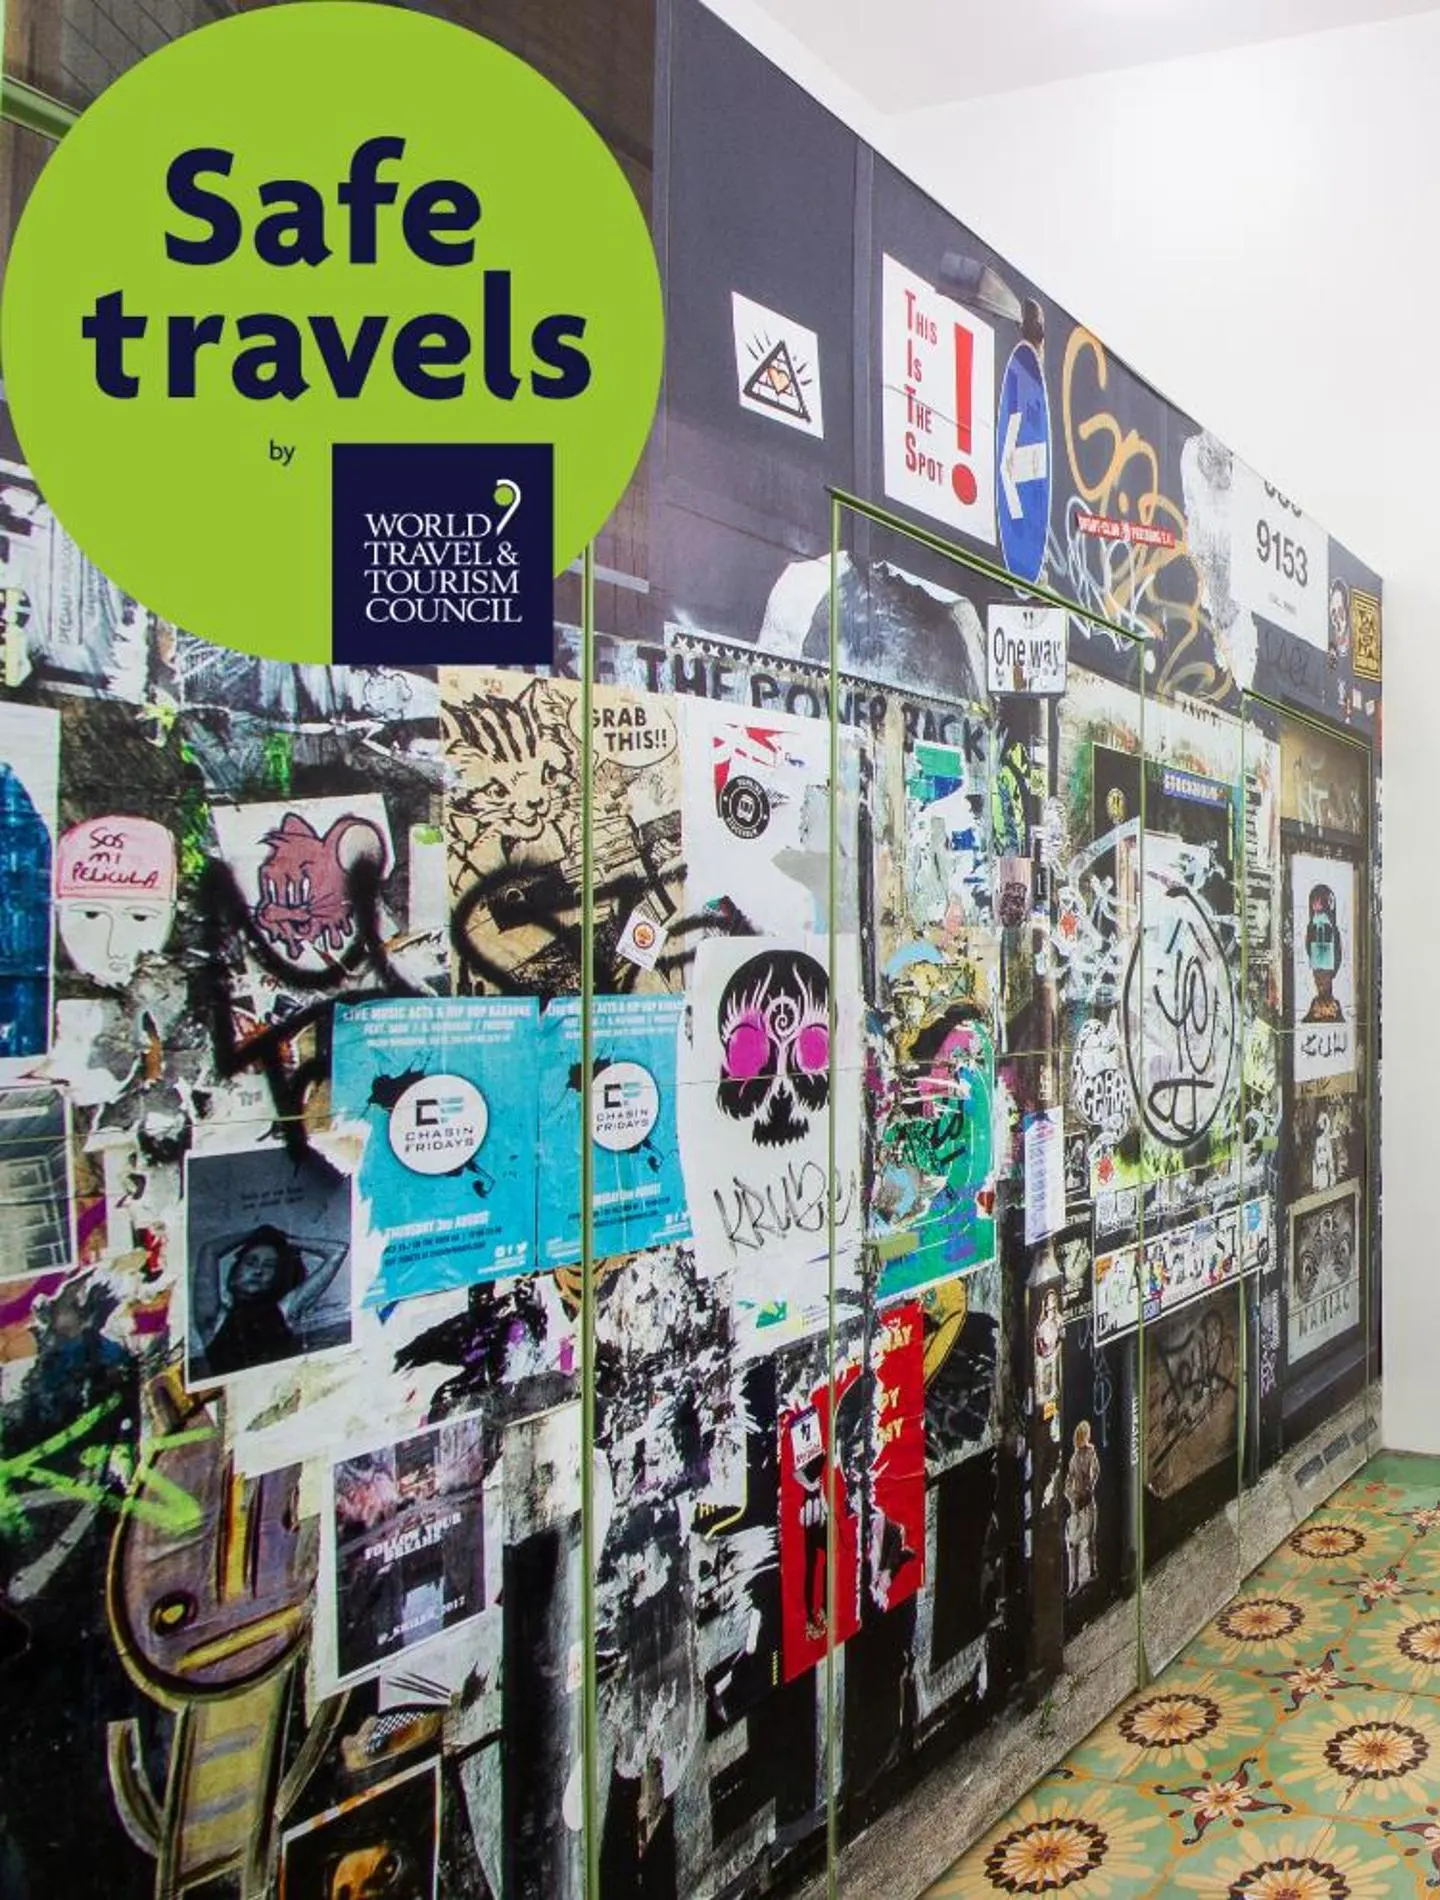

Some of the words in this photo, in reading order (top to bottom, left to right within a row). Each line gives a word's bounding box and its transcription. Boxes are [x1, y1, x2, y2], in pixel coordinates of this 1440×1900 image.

[1256, 518, 1308, 588] 9153
[994, 627, 1025, 666] One
[1030, 640, 1061, 676] way
[603, 728, 667, 752] THIS!!
[72, 861, 159, 888] PELICULA
[596, 1118, 650, 1133] FRIDAYS
[405, 1138, 475, 1153] FRIDAYS
